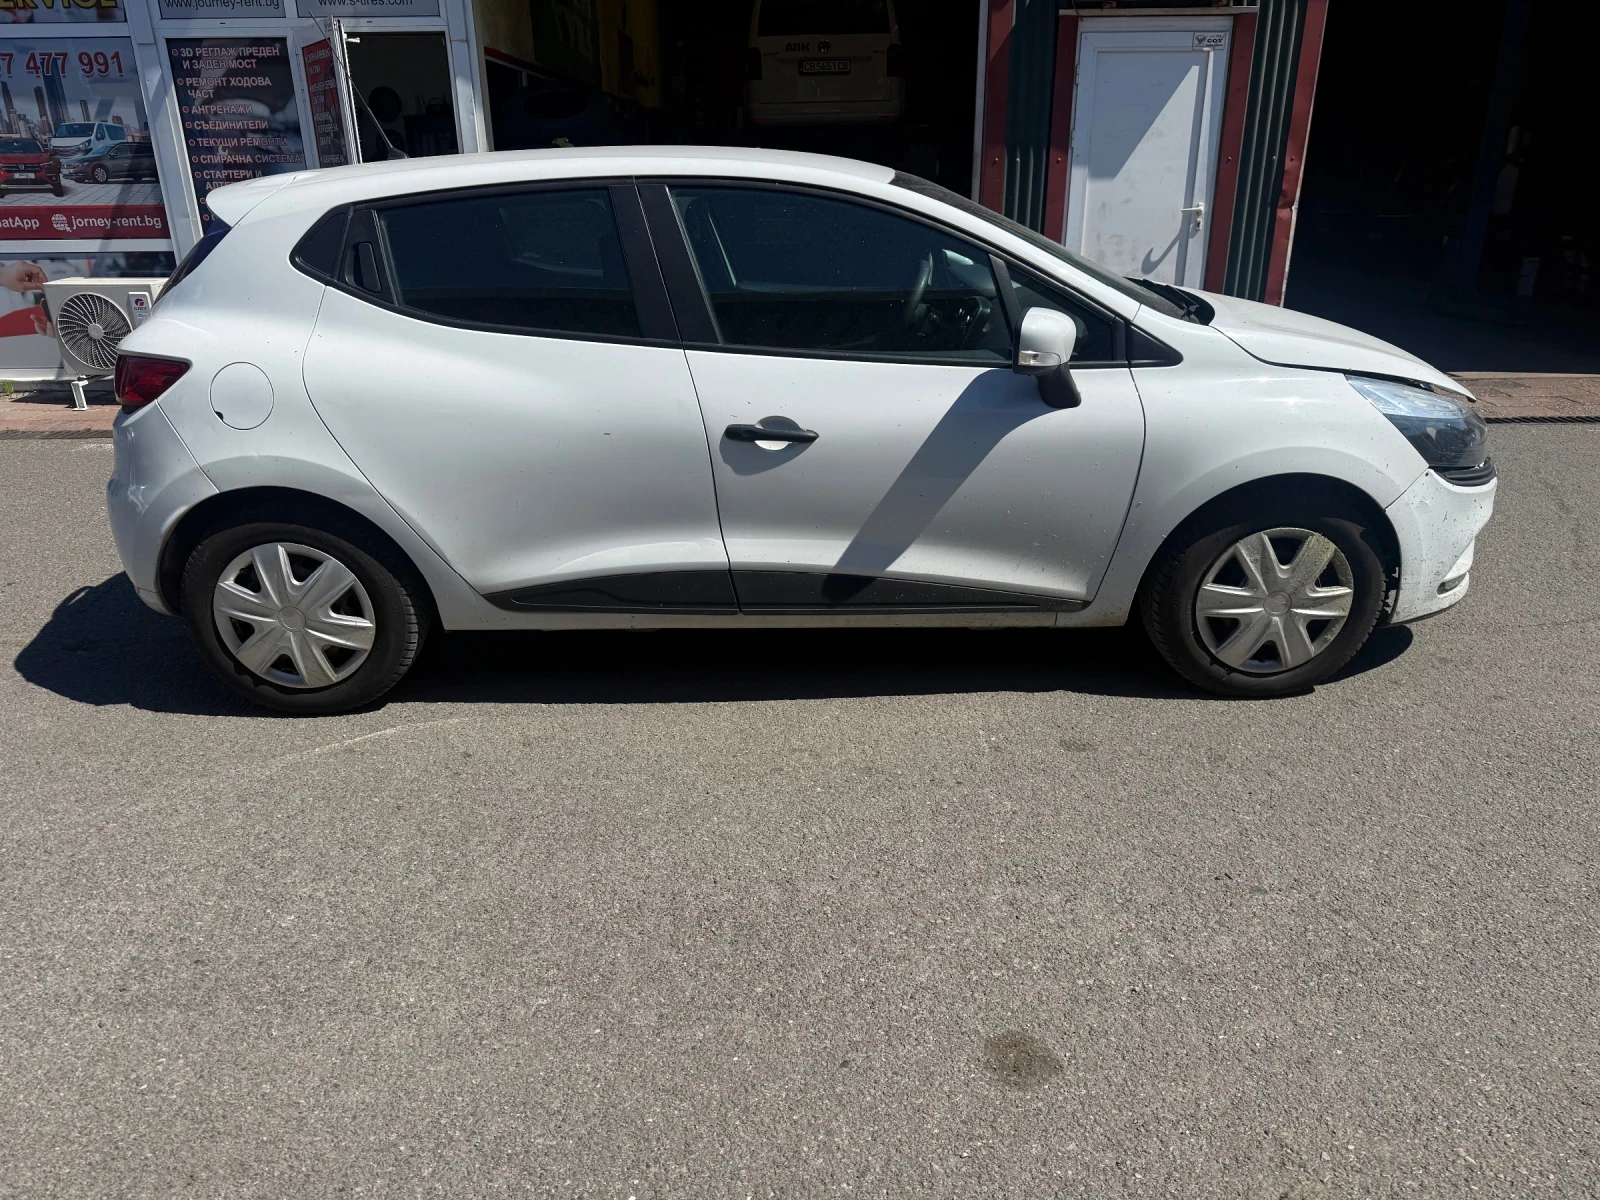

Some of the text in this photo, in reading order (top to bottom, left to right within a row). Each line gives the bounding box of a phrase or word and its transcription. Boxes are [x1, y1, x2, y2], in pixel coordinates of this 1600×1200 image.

[181, 46, 280, 57] 3D РЕГЛАЖ ПРЕДЕН
[26, 52, 68, 75] 477
[78, 51, 123, 75] 991
[182, 59, 257, 70] И ЗАДЕН МОСТ
[186, 76, 272, 87] РЕМОНТ ХОДОВА
[188, 89, 214, 98] ЧАСТ
[191, 105, 253, 114] АНГРЕНАЖИ
[194, 120, 268, 130] СЪЕДИНИТЕЛИ
[198, 137, 288, 148] ТЕКУЩИ РЕМОНТИ
[200, 154, 302, 164] СПИРАЧНА СИСТЕМА
[203, 170, 253, 179] СТАРТЕРИ
[0, 216, 40, 230] atApp
[71, 215, 162, 230] jorney-rent.bg
